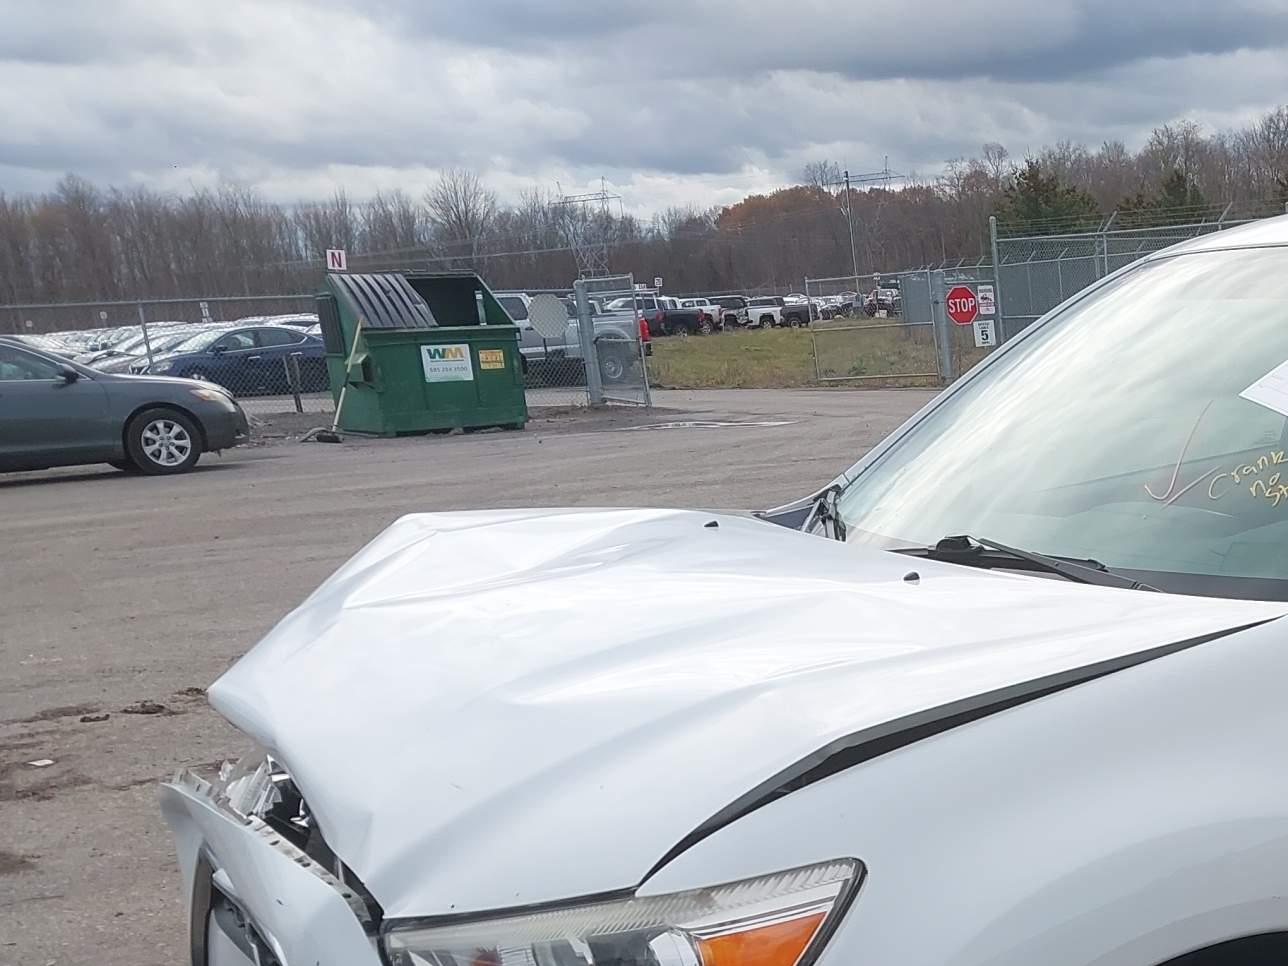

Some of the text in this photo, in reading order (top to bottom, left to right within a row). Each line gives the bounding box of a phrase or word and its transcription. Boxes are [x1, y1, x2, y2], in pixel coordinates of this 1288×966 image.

[331, 252, 342, 268] N
[948, 298, 975, 313] STOP
[981, 330, 989, 340] 5
[426, 347, 465, 360] WM
